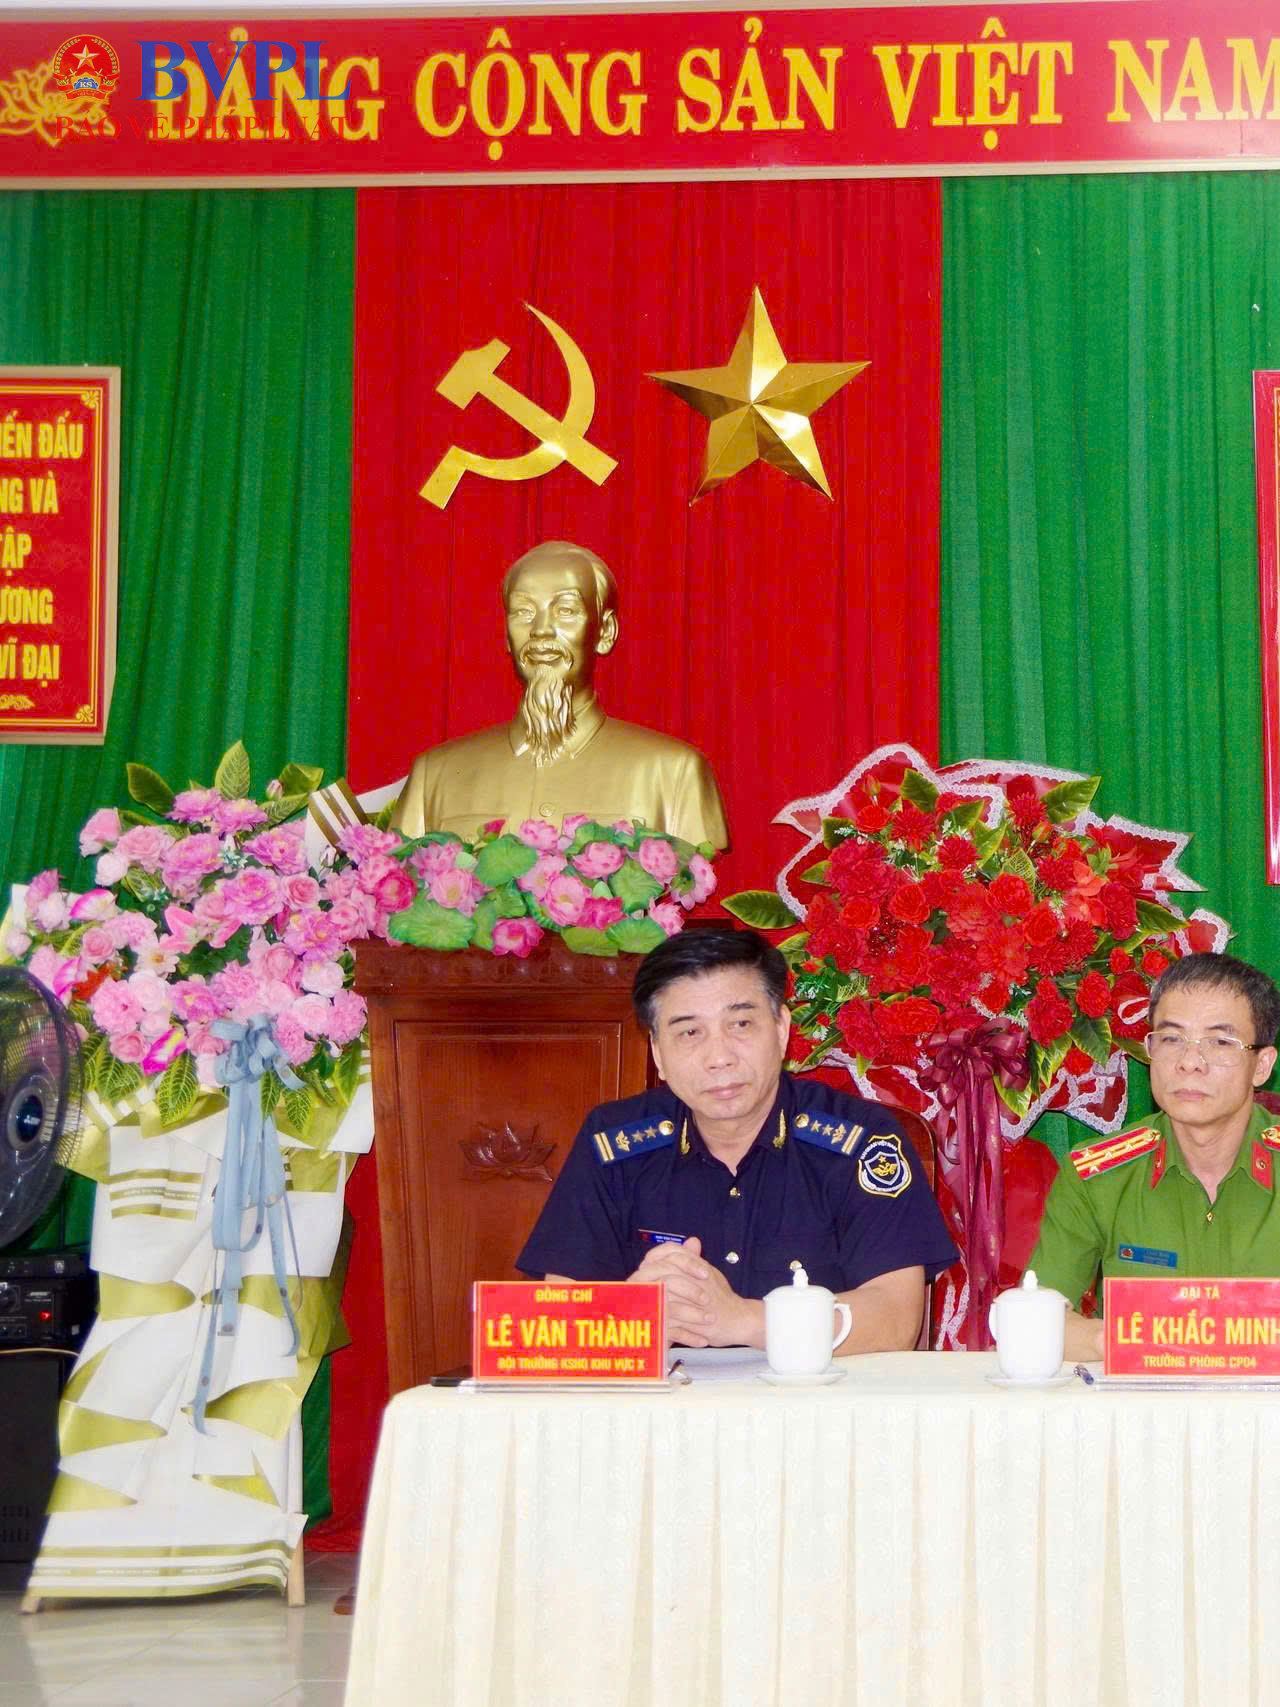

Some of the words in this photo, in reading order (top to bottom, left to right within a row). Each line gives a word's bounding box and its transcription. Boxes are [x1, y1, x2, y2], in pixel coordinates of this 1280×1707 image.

[415, 28, 648, 161] CỘNG
[677, 17, 843, 133] SẢN
[872, 17, 1074, 150] VIỆT
[0, 410, 32, 458] ẾN
[39, 410, 83, 459] ĐẤU
[30, 470, 59, 514] VÀ
[0, 525, 32, 577] ẬP
[23, 644, 60, 688] ĐẠI
[487, 1314, 512, 1347] LÊ
[520, 1315, 567, 1347] VĂN
[574, 1315, 651, 1347] THÀNH
[1117, 1312, 1144, 1344] LÊ
[1152, 1309, 1216, 1344] KHẮC
